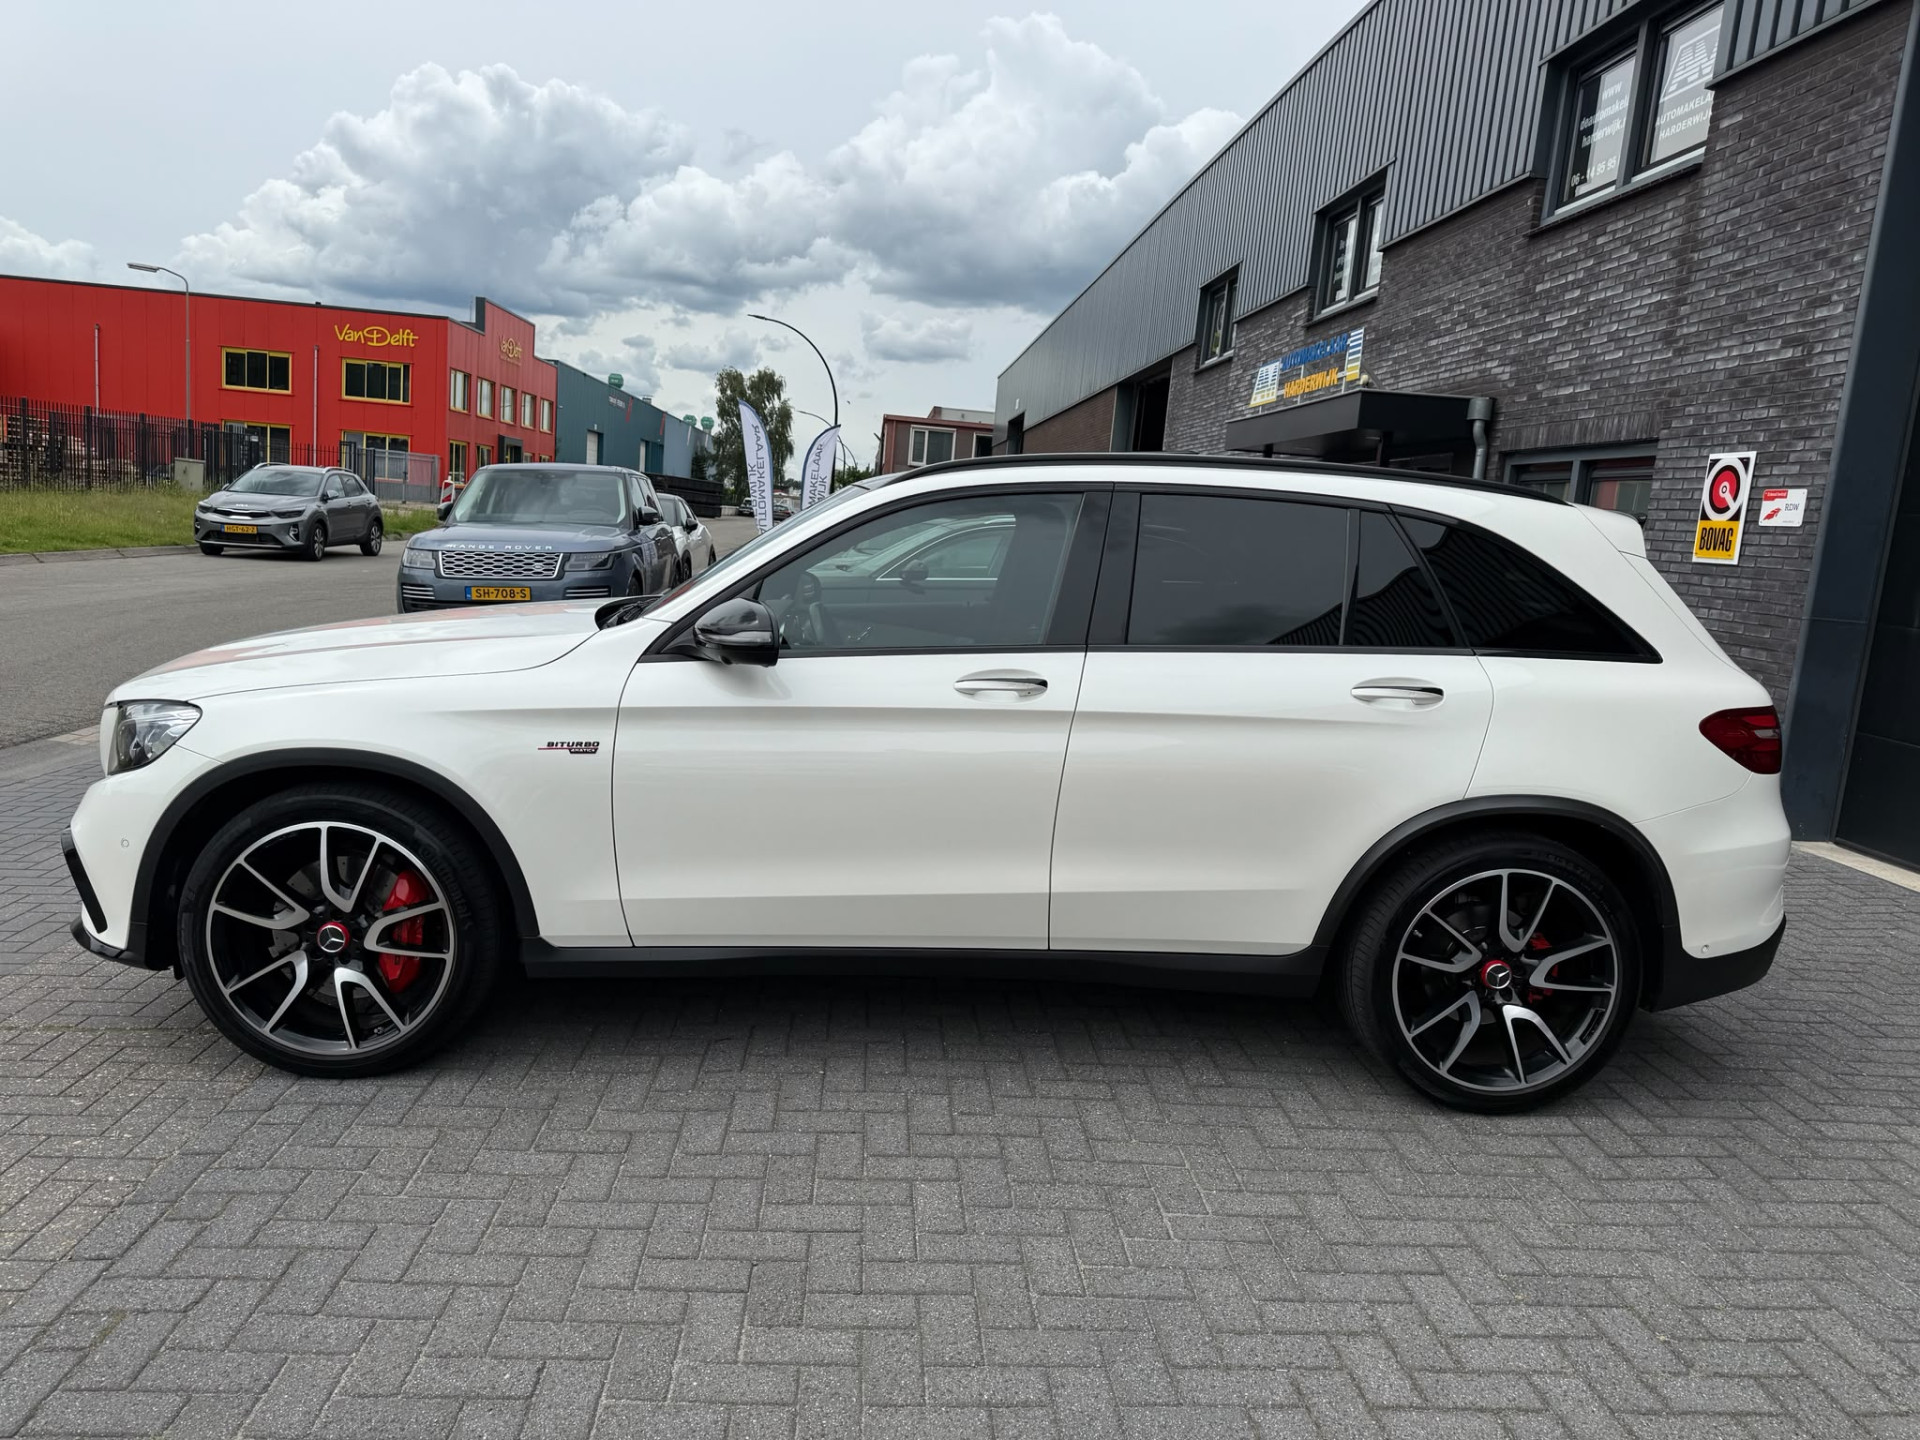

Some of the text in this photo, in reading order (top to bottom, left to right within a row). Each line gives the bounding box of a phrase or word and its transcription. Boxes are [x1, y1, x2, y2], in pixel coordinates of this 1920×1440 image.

[1580, 95, 1629, 131] deautomakel
[1655, 91, 1714, 127] AUTOMAKELA
[1283, 367, 1339, 398] HARDERWIJK
[1784, 503, 1800, 511] RDW
[1699, 527, 1734, 552] BOVAG
[475, 588, 527, 599] SH-708-S
